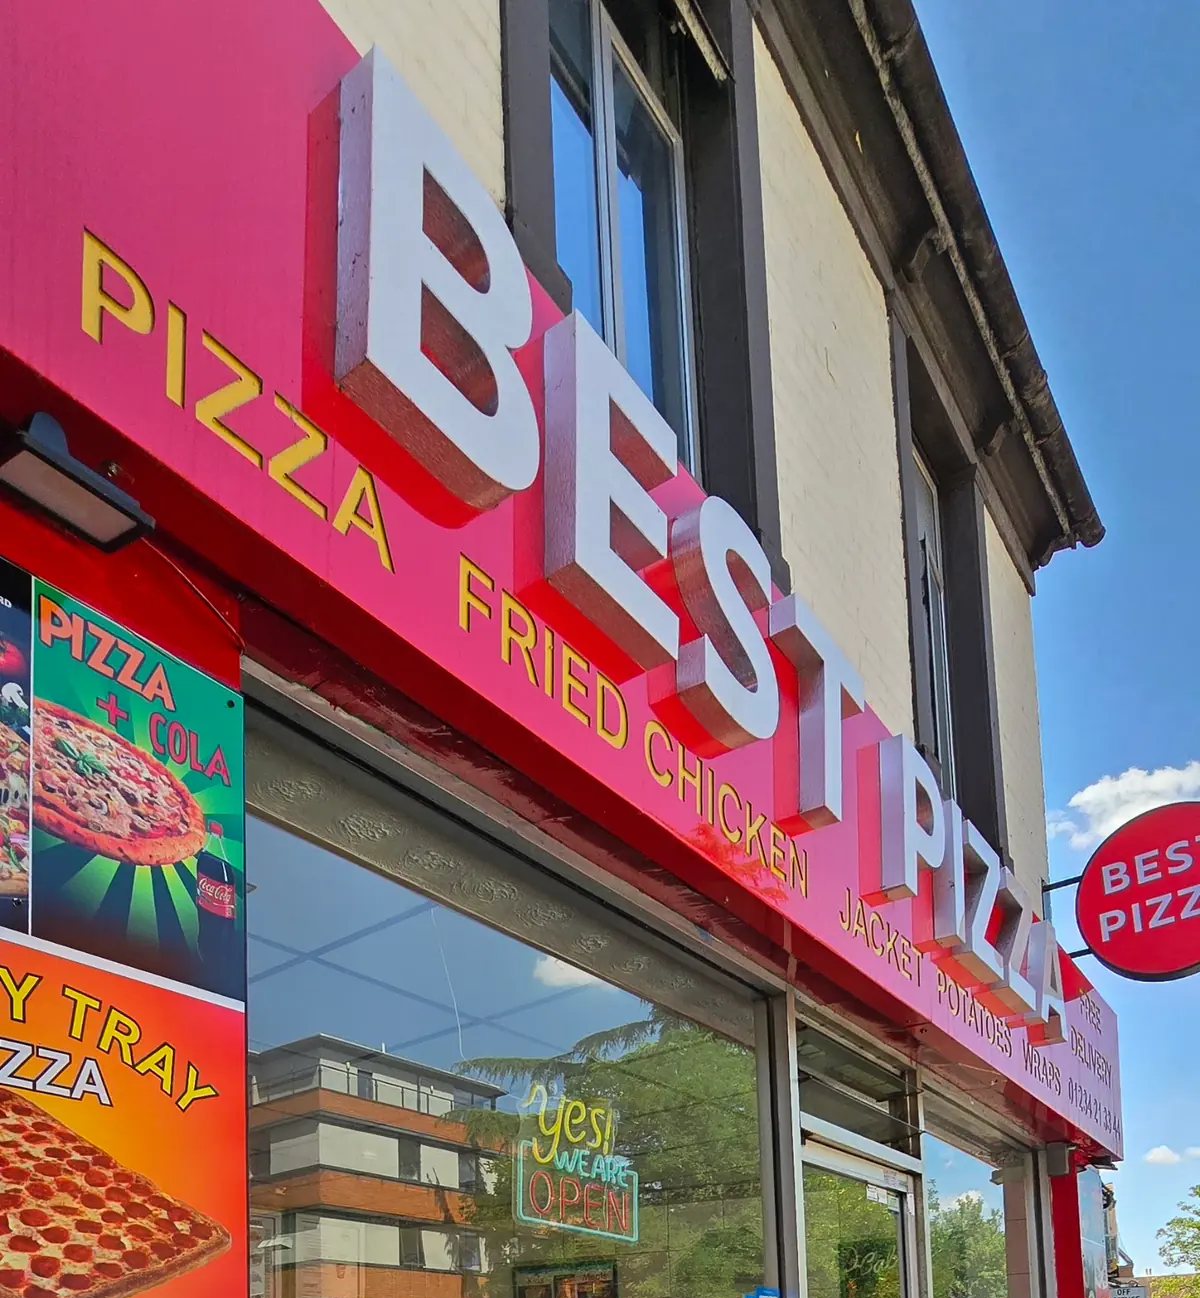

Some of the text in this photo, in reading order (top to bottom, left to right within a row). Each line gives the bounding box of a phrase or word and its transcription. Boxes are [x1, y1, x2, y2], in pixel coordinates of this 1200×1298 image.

[335, 43, 1068, 1046] BEST PIZZA
[38, 594, 175, 711] PIZZA
[81, 225, 1062, 1096] PIZZA FRIED CHICKEN JACKET POTATOES WRAPS
[148, 711, 232, 787] COLA
[1101, 835, 1200, 895] BES
[1079, 988, 1102, 1036] FREE
[0, 1037, 113, 1107] ZZA
[62, 984, 218, 1112] TRAY
[1070, 1024, 1112, 1090] DELIVERY
[1067, 1077, 1093, 1119] 01234
[529, 1170, 630, 1232] OPEN
